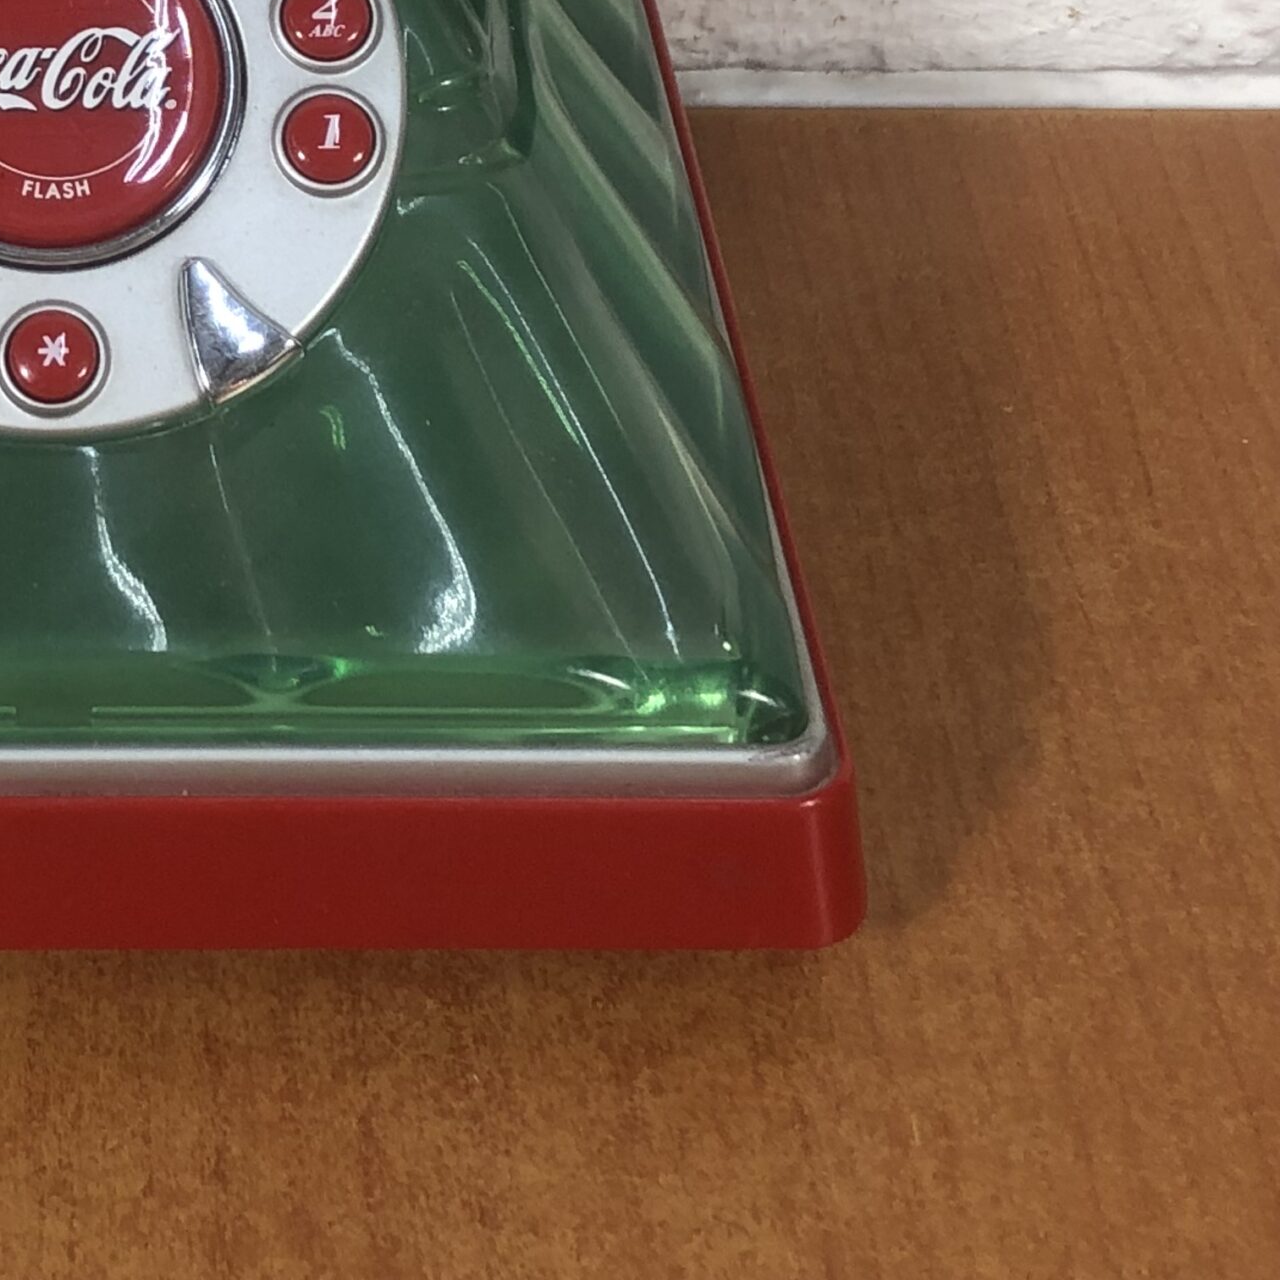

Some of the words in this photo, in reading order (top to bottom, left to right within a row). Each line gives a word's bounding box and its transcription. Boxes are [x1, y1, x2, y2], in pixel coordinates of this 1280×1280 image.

[308, 24, 345, 38] ABC
[318, 114, 341, 149] 1
[21, 179, 91, 200] FLASH
